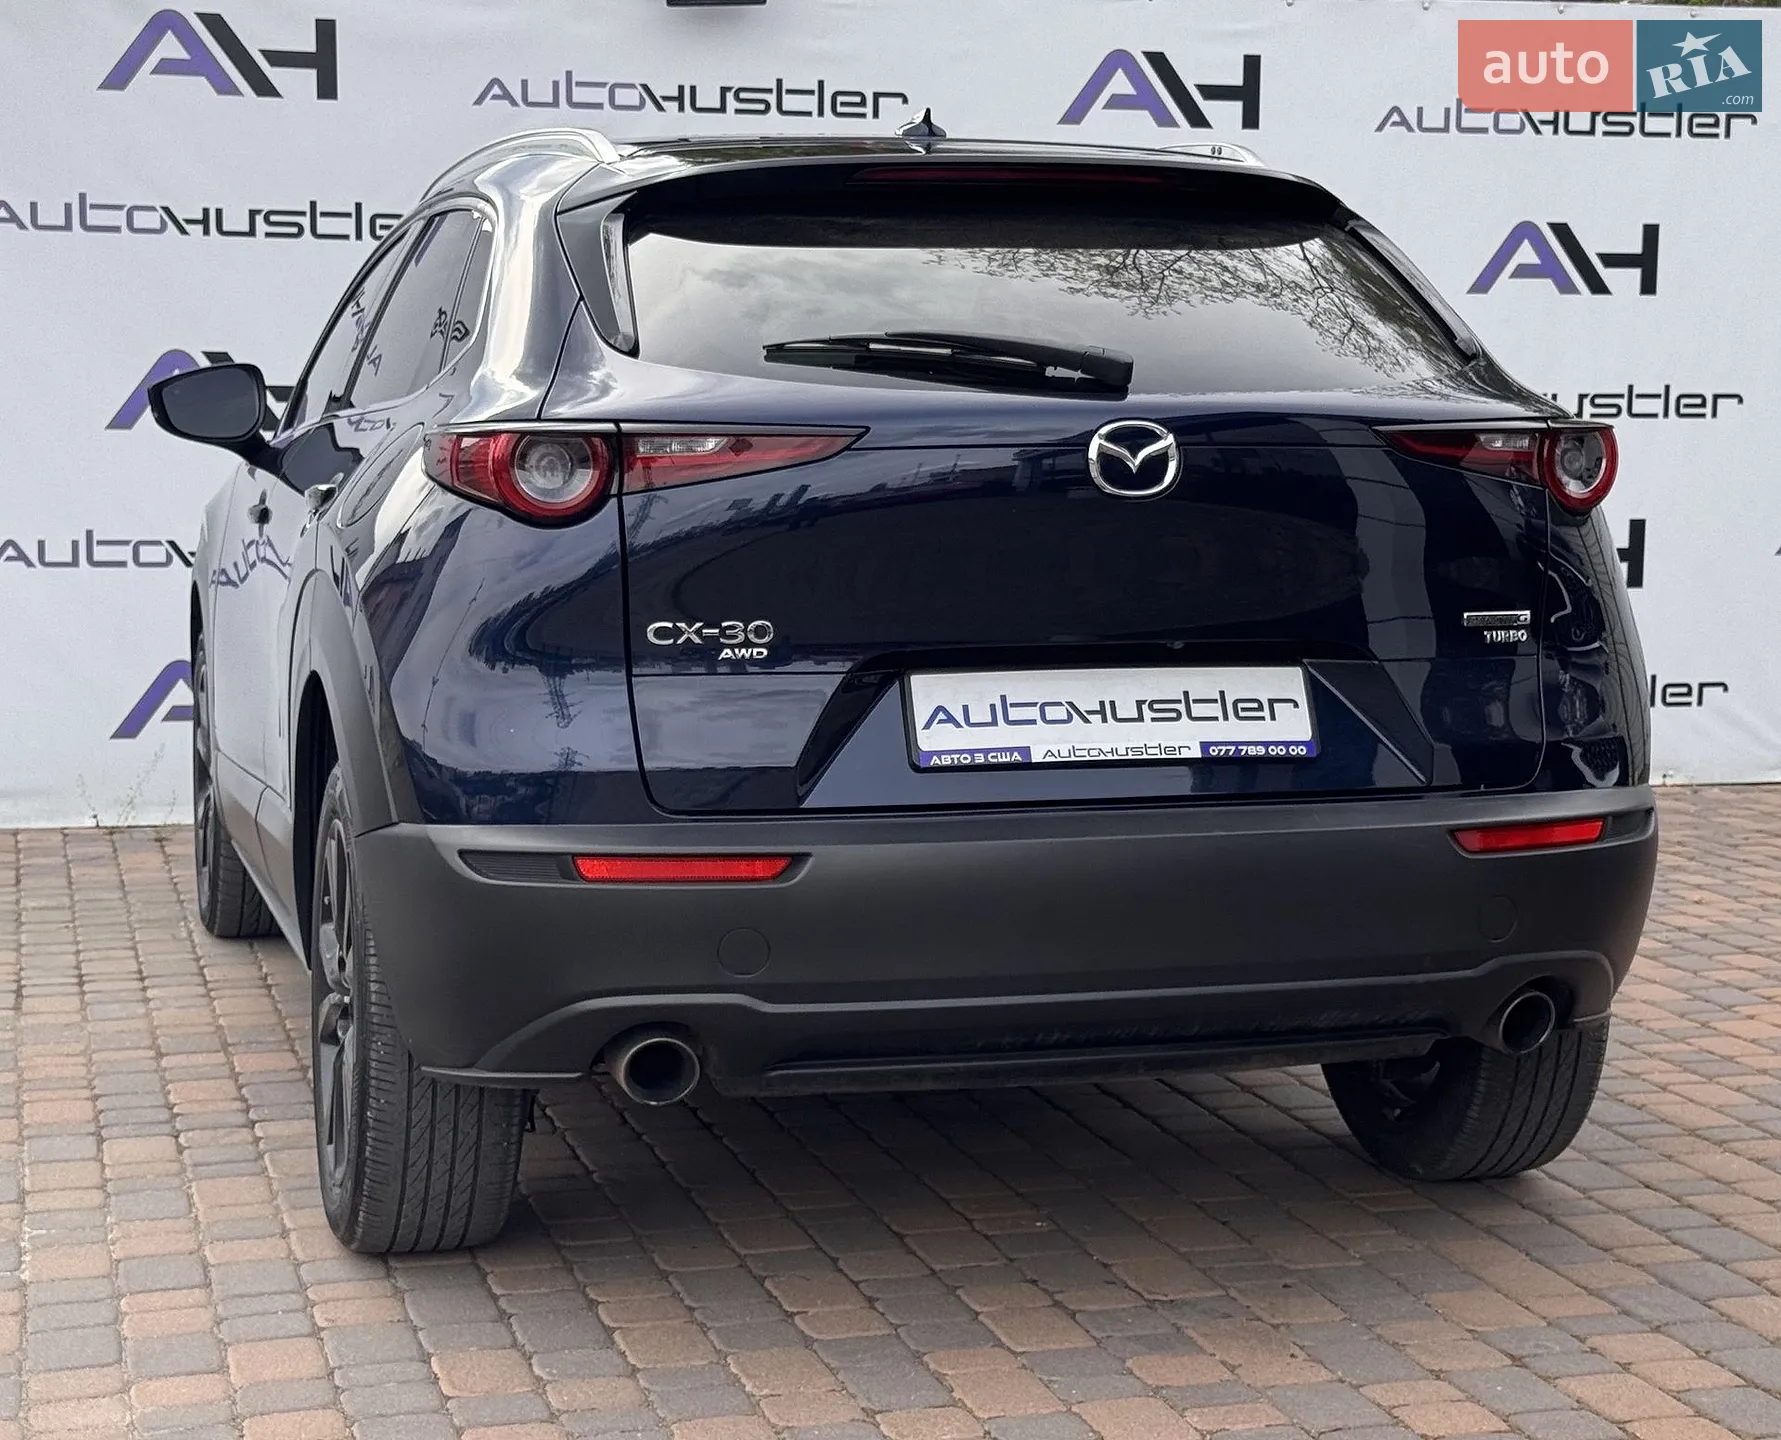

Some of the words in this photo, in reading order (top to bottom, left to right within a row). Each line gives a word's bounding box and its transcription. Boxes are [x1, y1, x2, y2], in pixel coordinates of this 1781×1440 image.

[97, 8, 338, 100] AH
[1057, 48, 1262, 130] AH
[1466, 220, 1659, 296] AH
[646, 620, 774, 646] CX-30
[1483, 629, 1528, 644] TURBO
[717, 647, 768, 660] AWD
[930, 753, 971, 766] АВТО
[987, 751, 1022, 763] США
[1209, 746, 1235, 756] 077
[1236, 746, 1265, 756] 789
[1268, 745, 1288, 755] 00
[1288, 745, 1307, 755] 00
